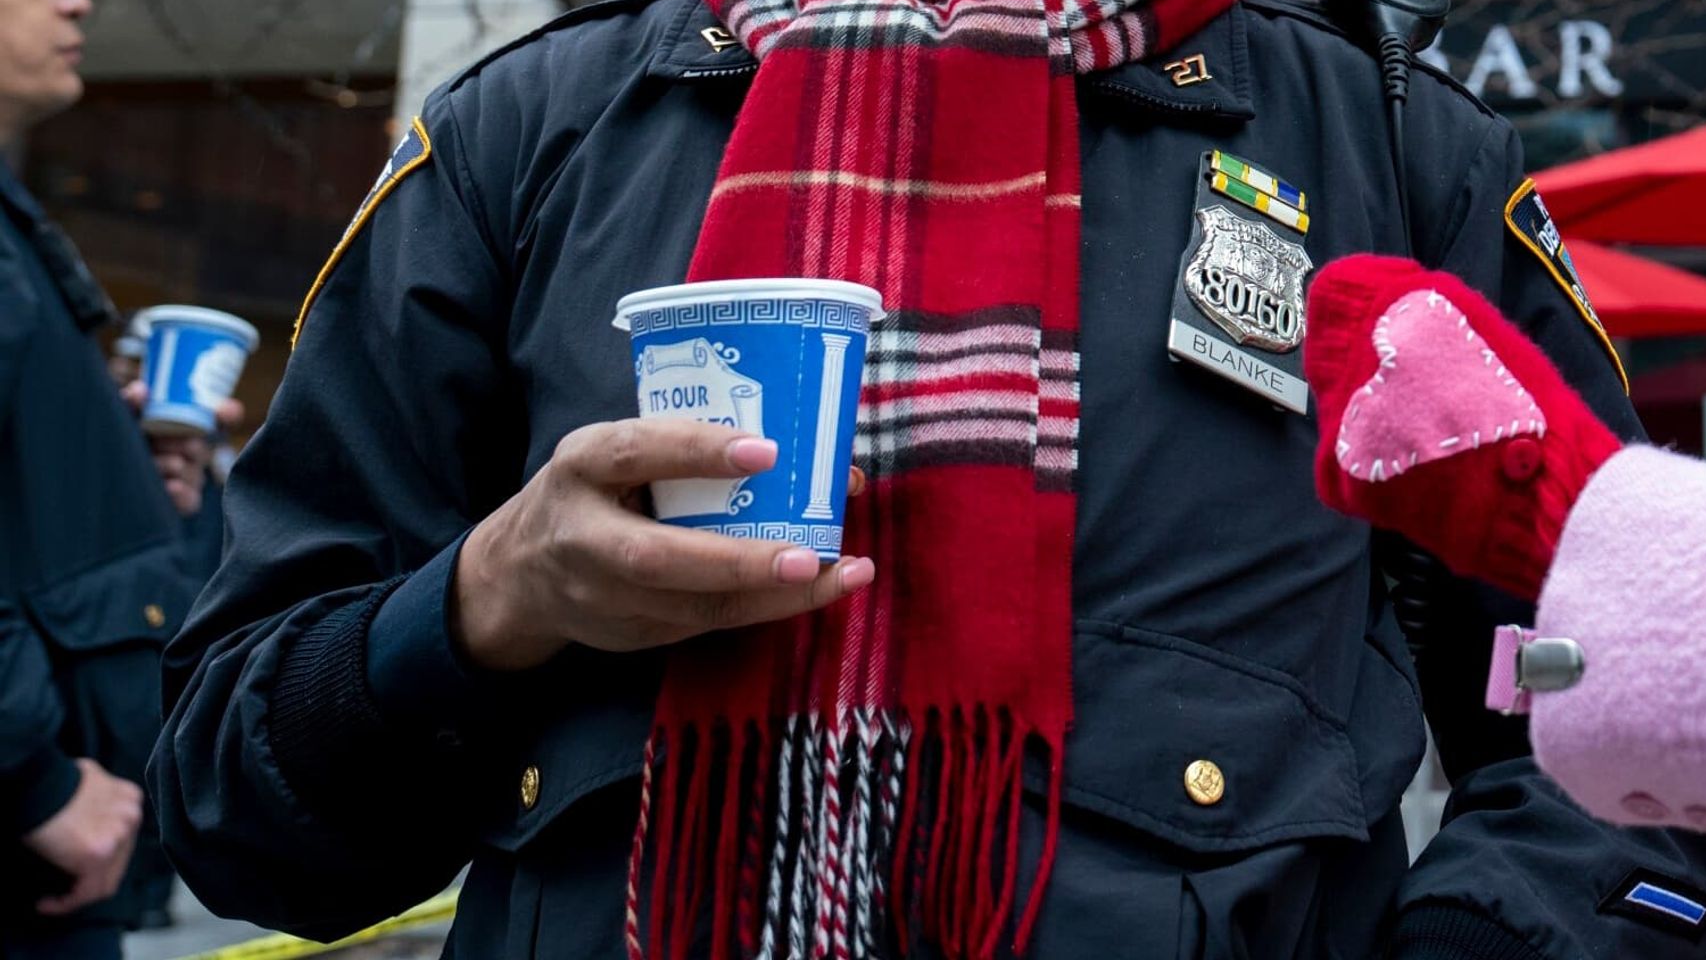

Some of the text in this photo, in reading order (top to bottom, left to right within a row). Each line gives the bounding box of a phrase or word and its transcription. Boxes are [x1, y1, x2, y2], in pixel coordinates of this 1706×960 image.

[1164, 54, 1212, 86] 21
[1203, 268, 1297, 339] 80160
[1193, 333, 1284, 393] BLANKE
[672, 385, 709, 409] OUR
